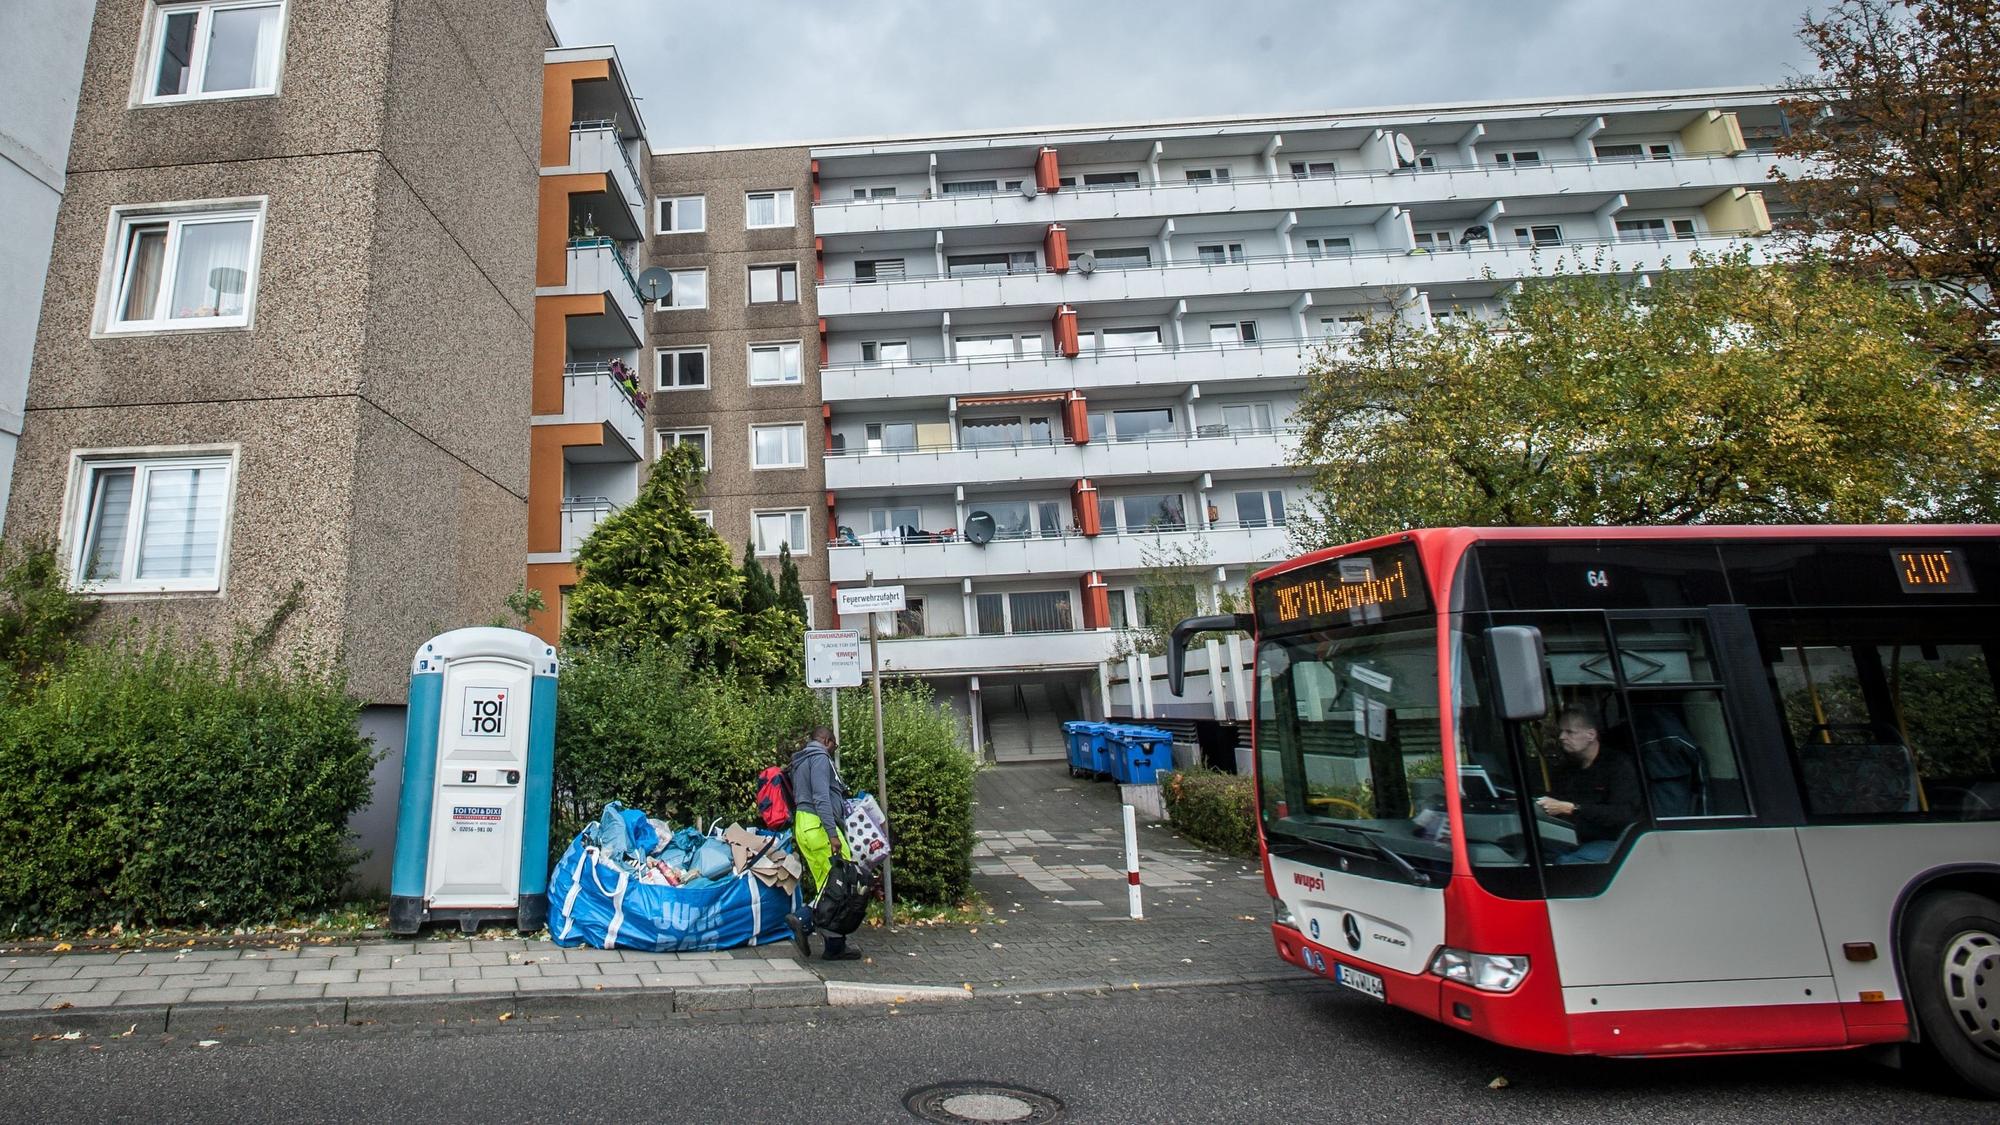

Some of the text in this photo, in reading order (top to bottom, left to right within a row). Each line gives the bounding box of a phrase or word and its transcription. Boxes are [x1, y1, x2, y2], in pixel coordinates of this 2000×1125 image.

[1587, 570, 1609, 588] 64
[842, 592, 900, 605] Feuerwehrzufahrt
[472, 717, 502, 733] TOI
[1294, 872, 1325, 892] wupsi
[653, 901, 722, 933] JUNK
[1373, 933, 1406, 947] CITARO
